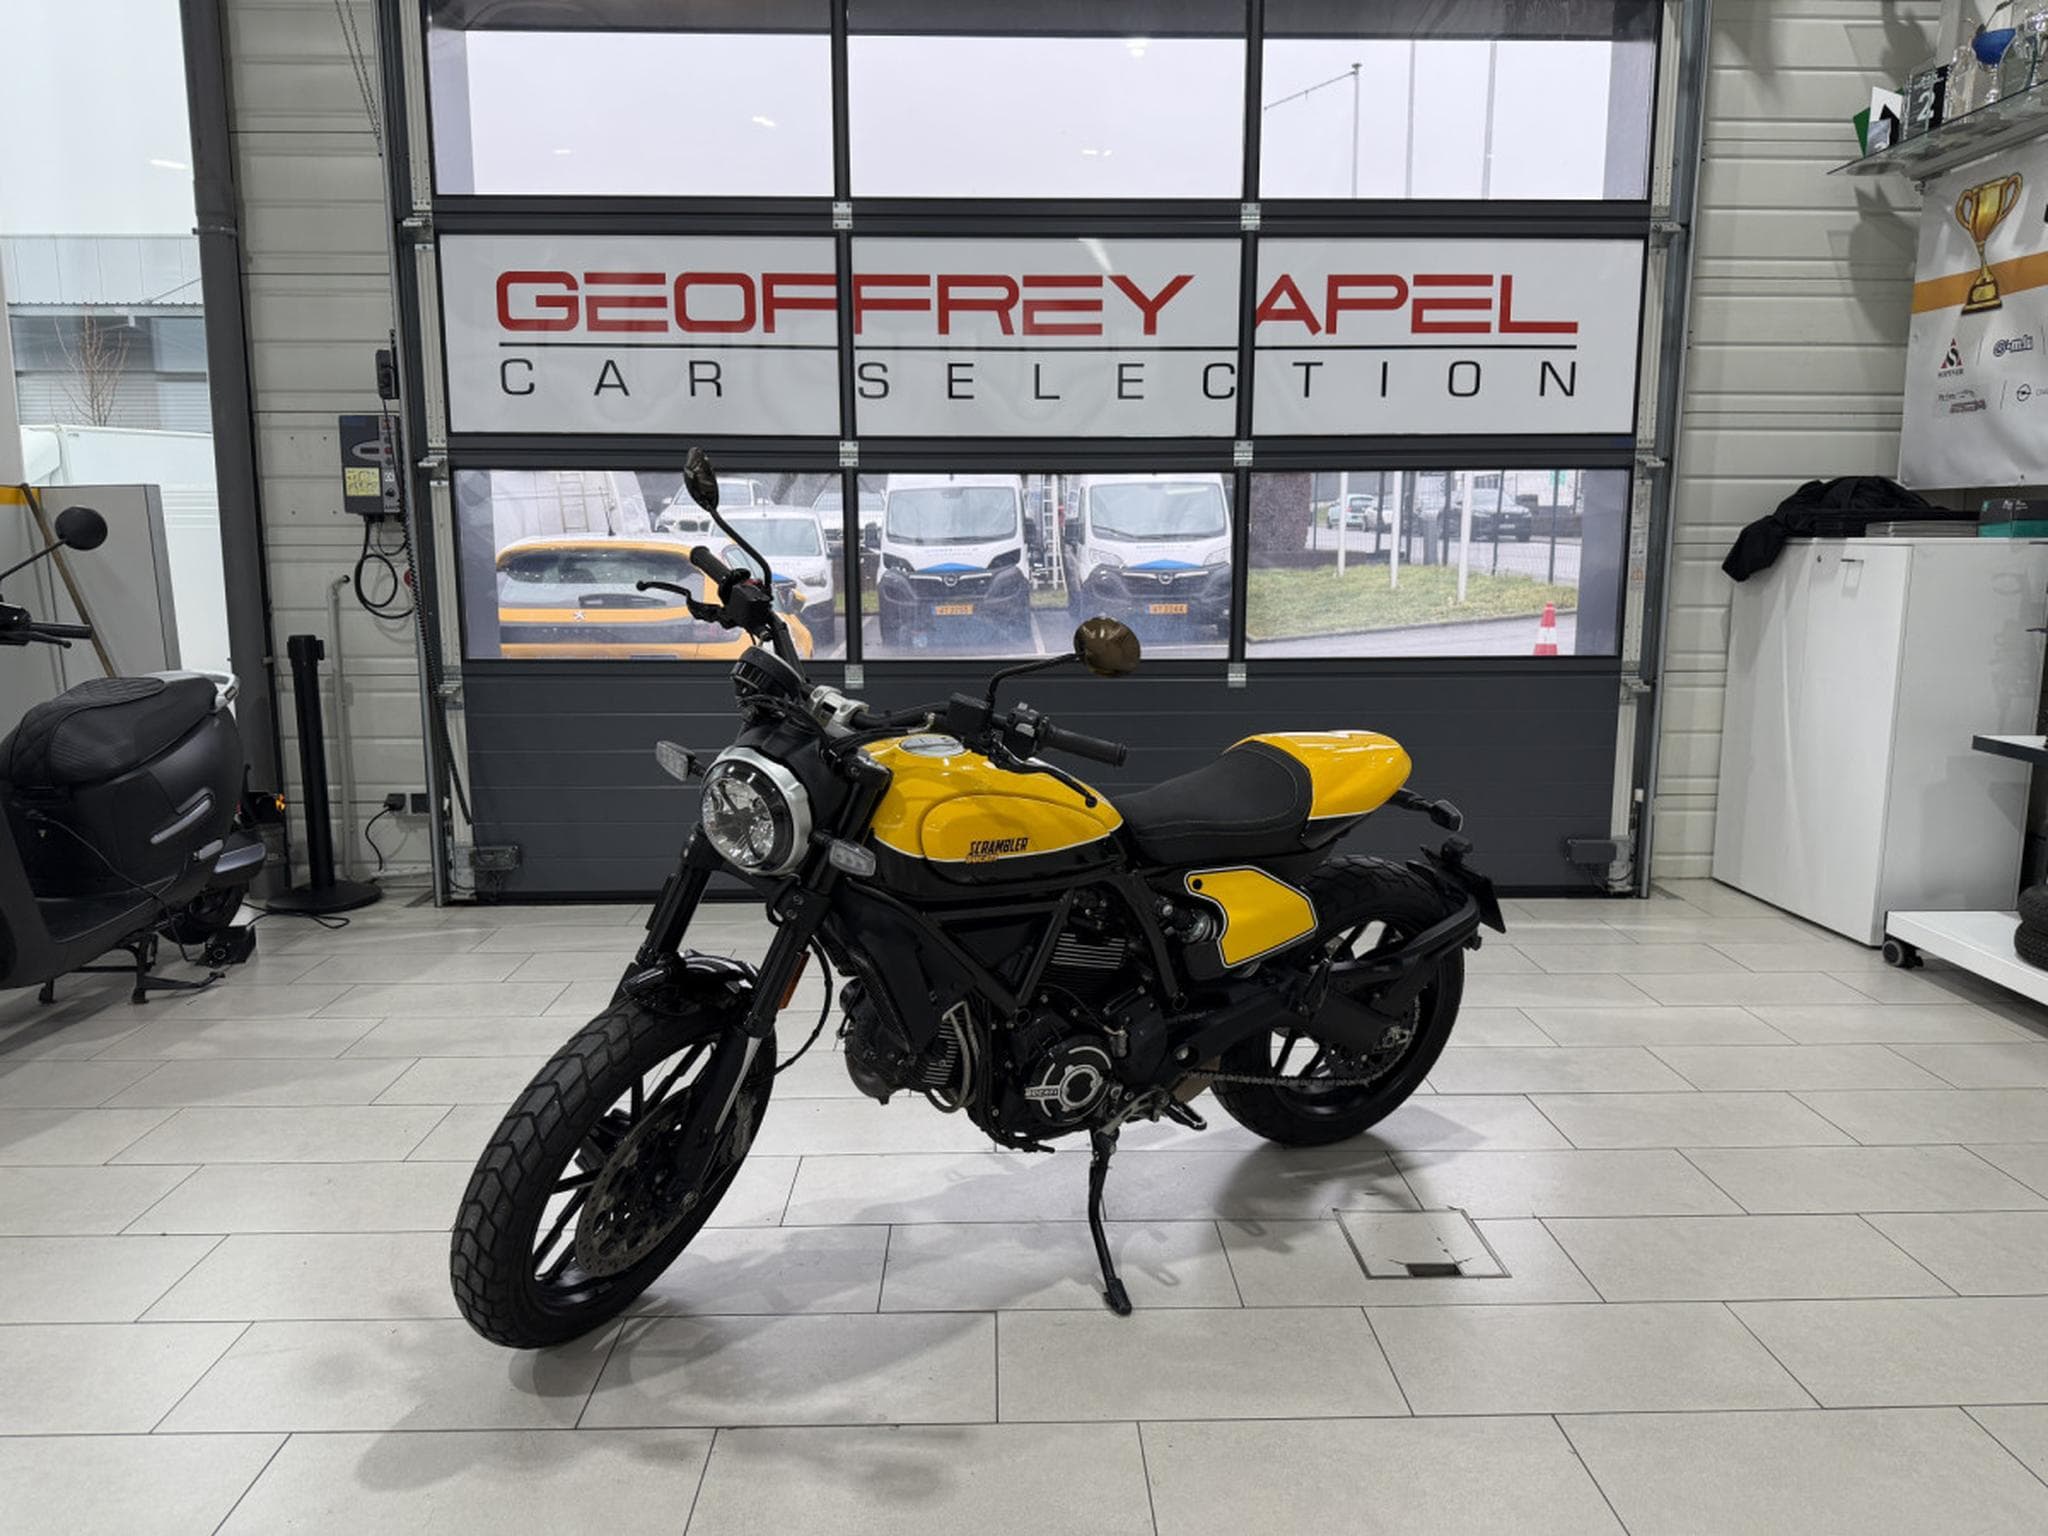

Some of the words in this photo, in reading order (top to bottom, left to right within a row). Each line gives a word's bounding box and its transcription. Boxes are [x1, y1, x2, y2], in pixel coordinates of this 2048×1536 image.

[496, 271, 1195, 335] GEOFFREY
[1255, 274, 1578, 335] APEL
[500, 358, 723, 398] CAR
[857, 360, 1577, 400] SELECTION
[969, 837, 1028, 856] SCRAMBLER
